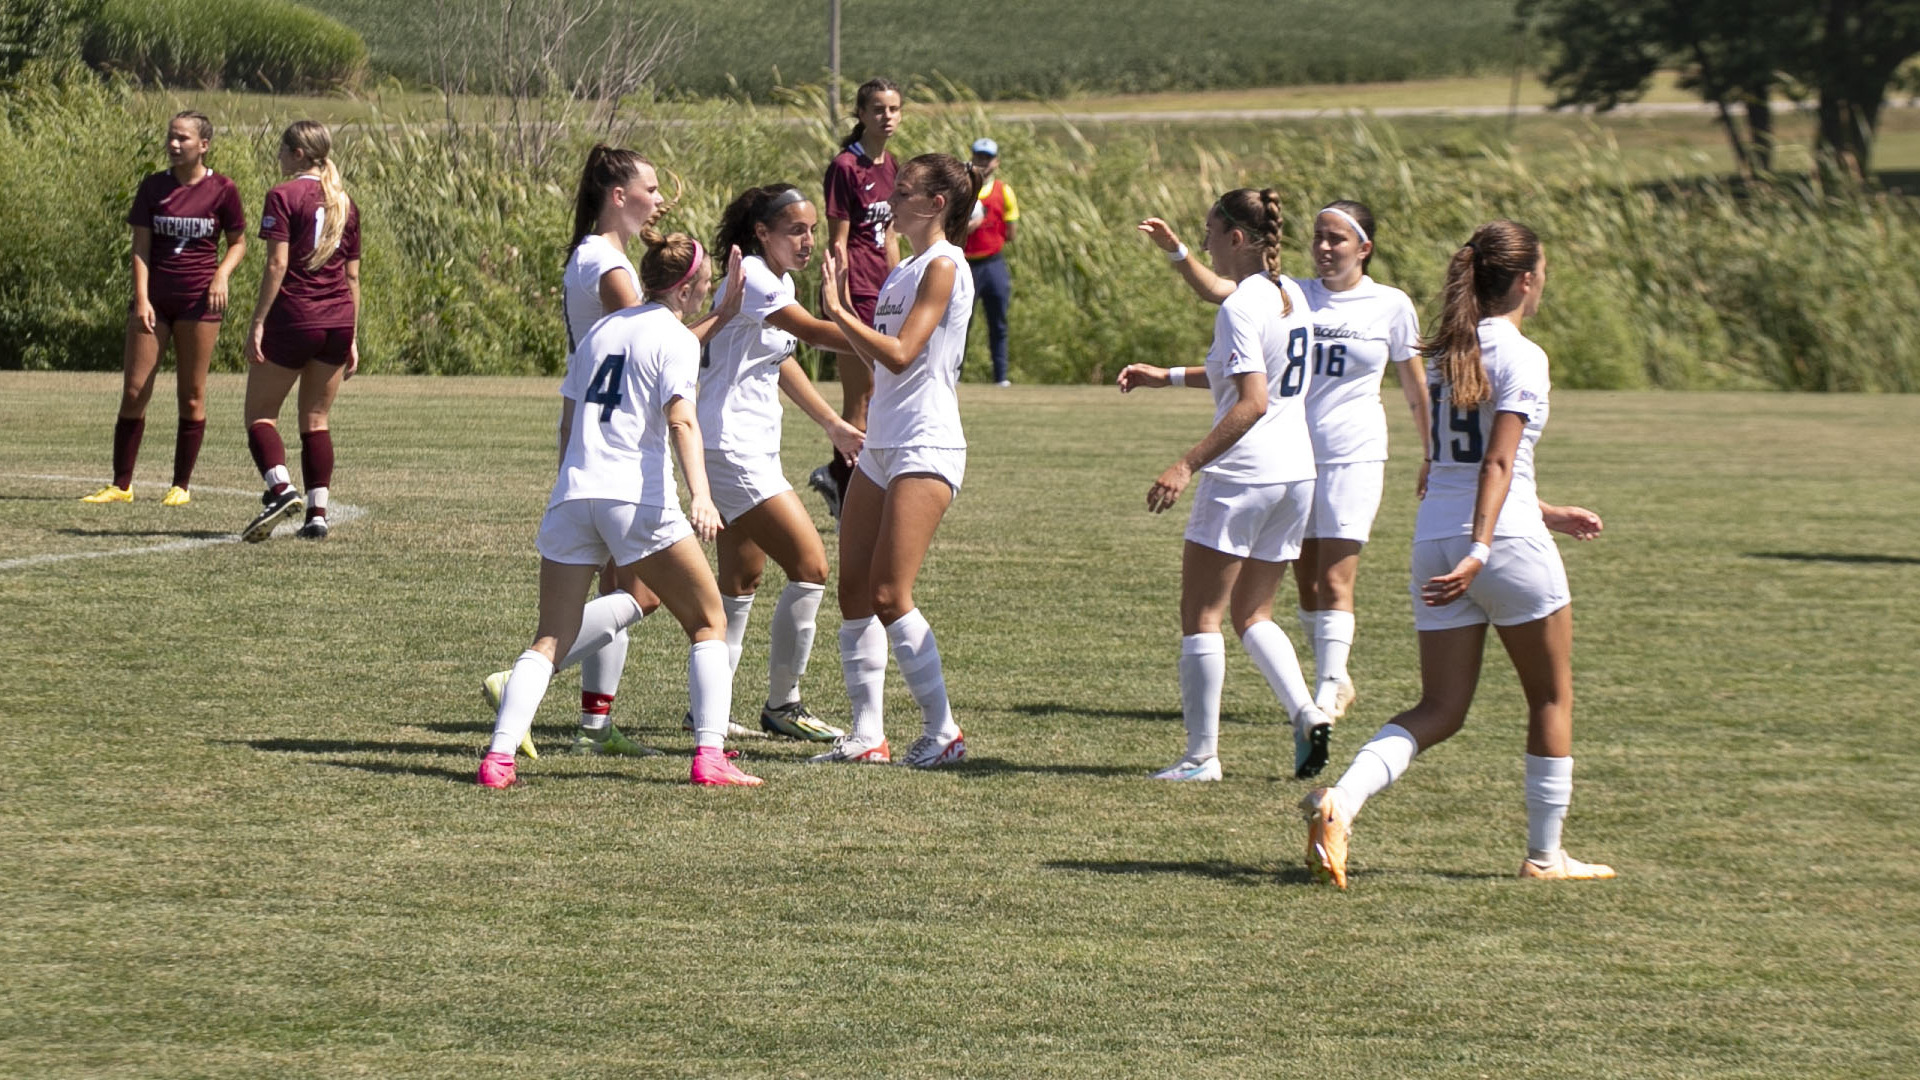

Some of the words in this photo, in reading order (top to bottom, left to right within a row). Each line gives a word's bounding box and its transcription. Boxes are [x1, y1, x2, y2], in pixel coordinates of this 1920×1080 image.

[153, 215, 215, 238] STEPHENS
[174, 236, 190, 254] 7
[1280, 326, 1308, 398] 8
[1313, 342, 1347, 377] 16
[584, 354, 627, 422] 4
